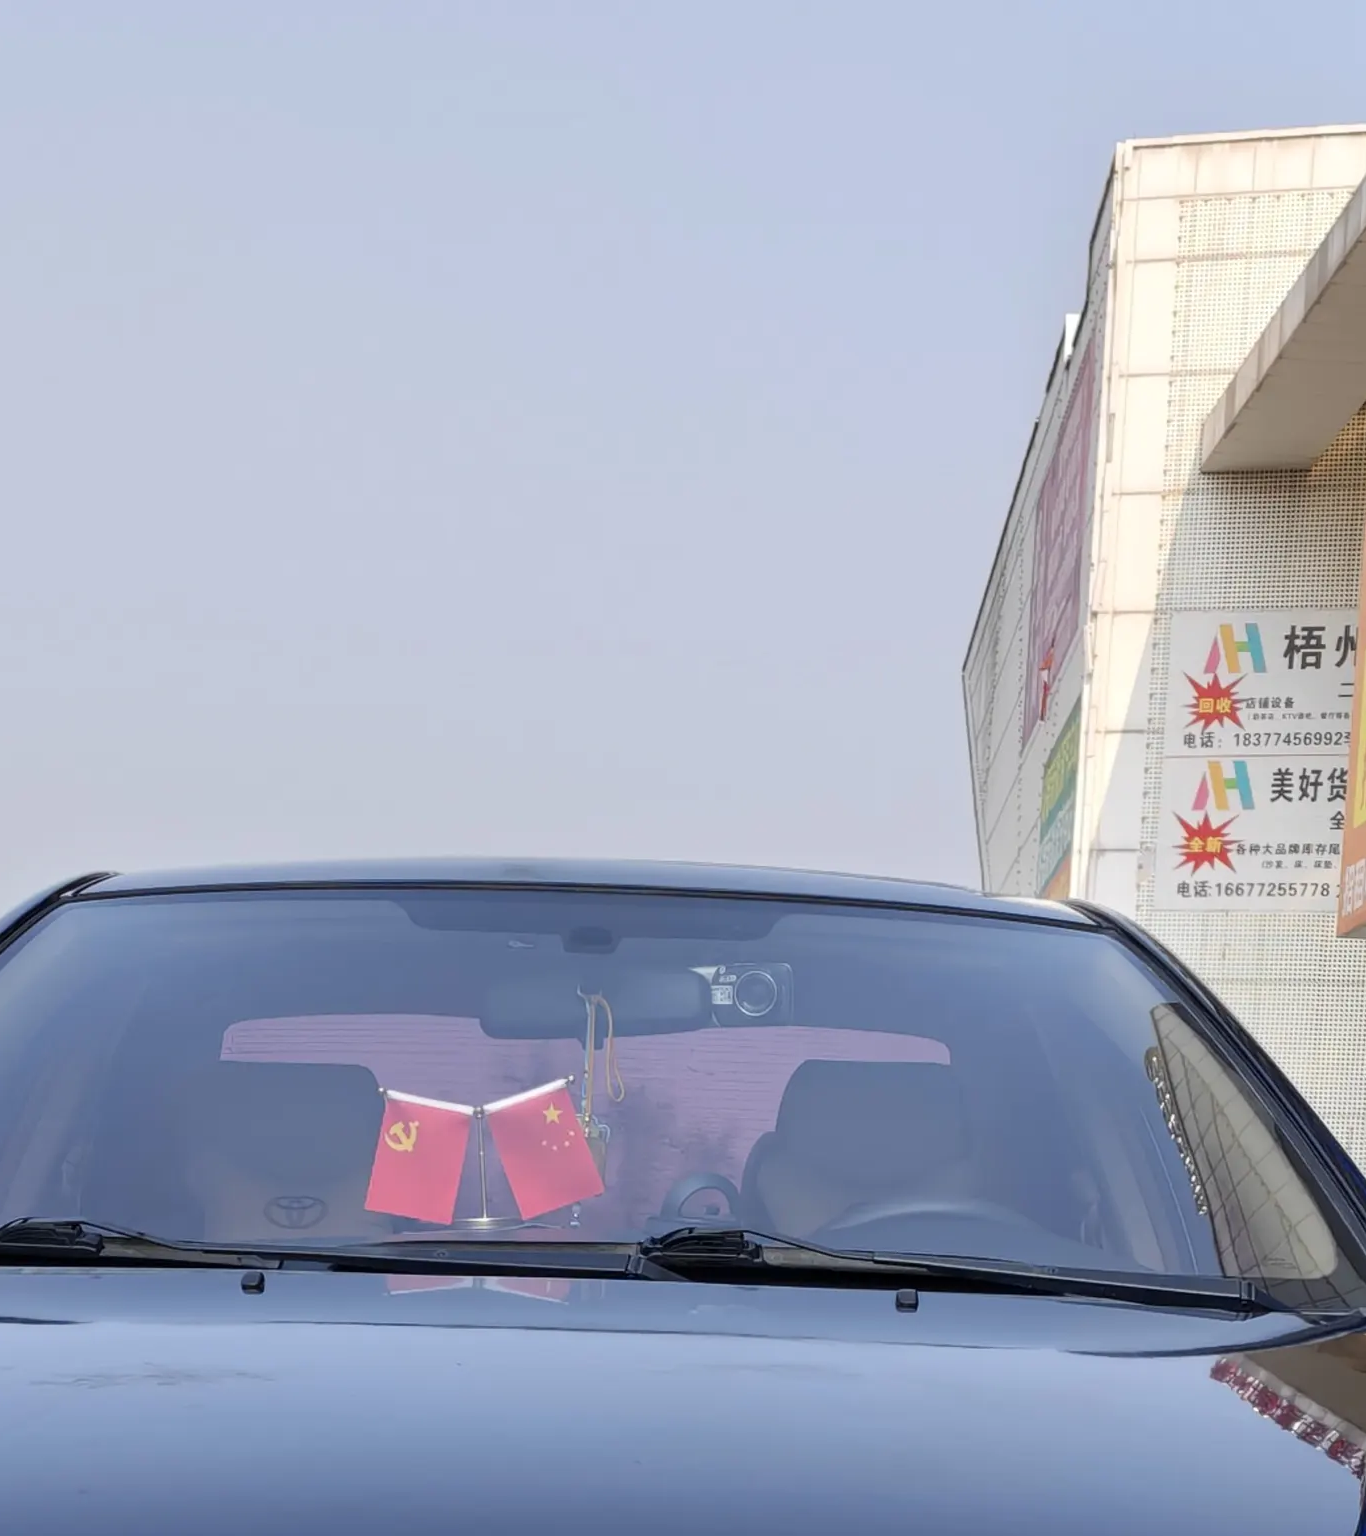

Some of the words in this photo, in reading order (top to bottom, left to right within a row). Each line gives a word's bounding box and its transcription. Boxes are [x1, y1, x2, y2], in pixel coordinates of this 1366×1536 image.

[1198, 697, 1233, 714] 回收
[1245, 697, 1295, 710] 店铺设备
[1270, 767, 1349, 802] 美好货
[1187, 837, 1224, 855] 全新
[1236, 842, 1341, 856] 各种大品牌库存尾
